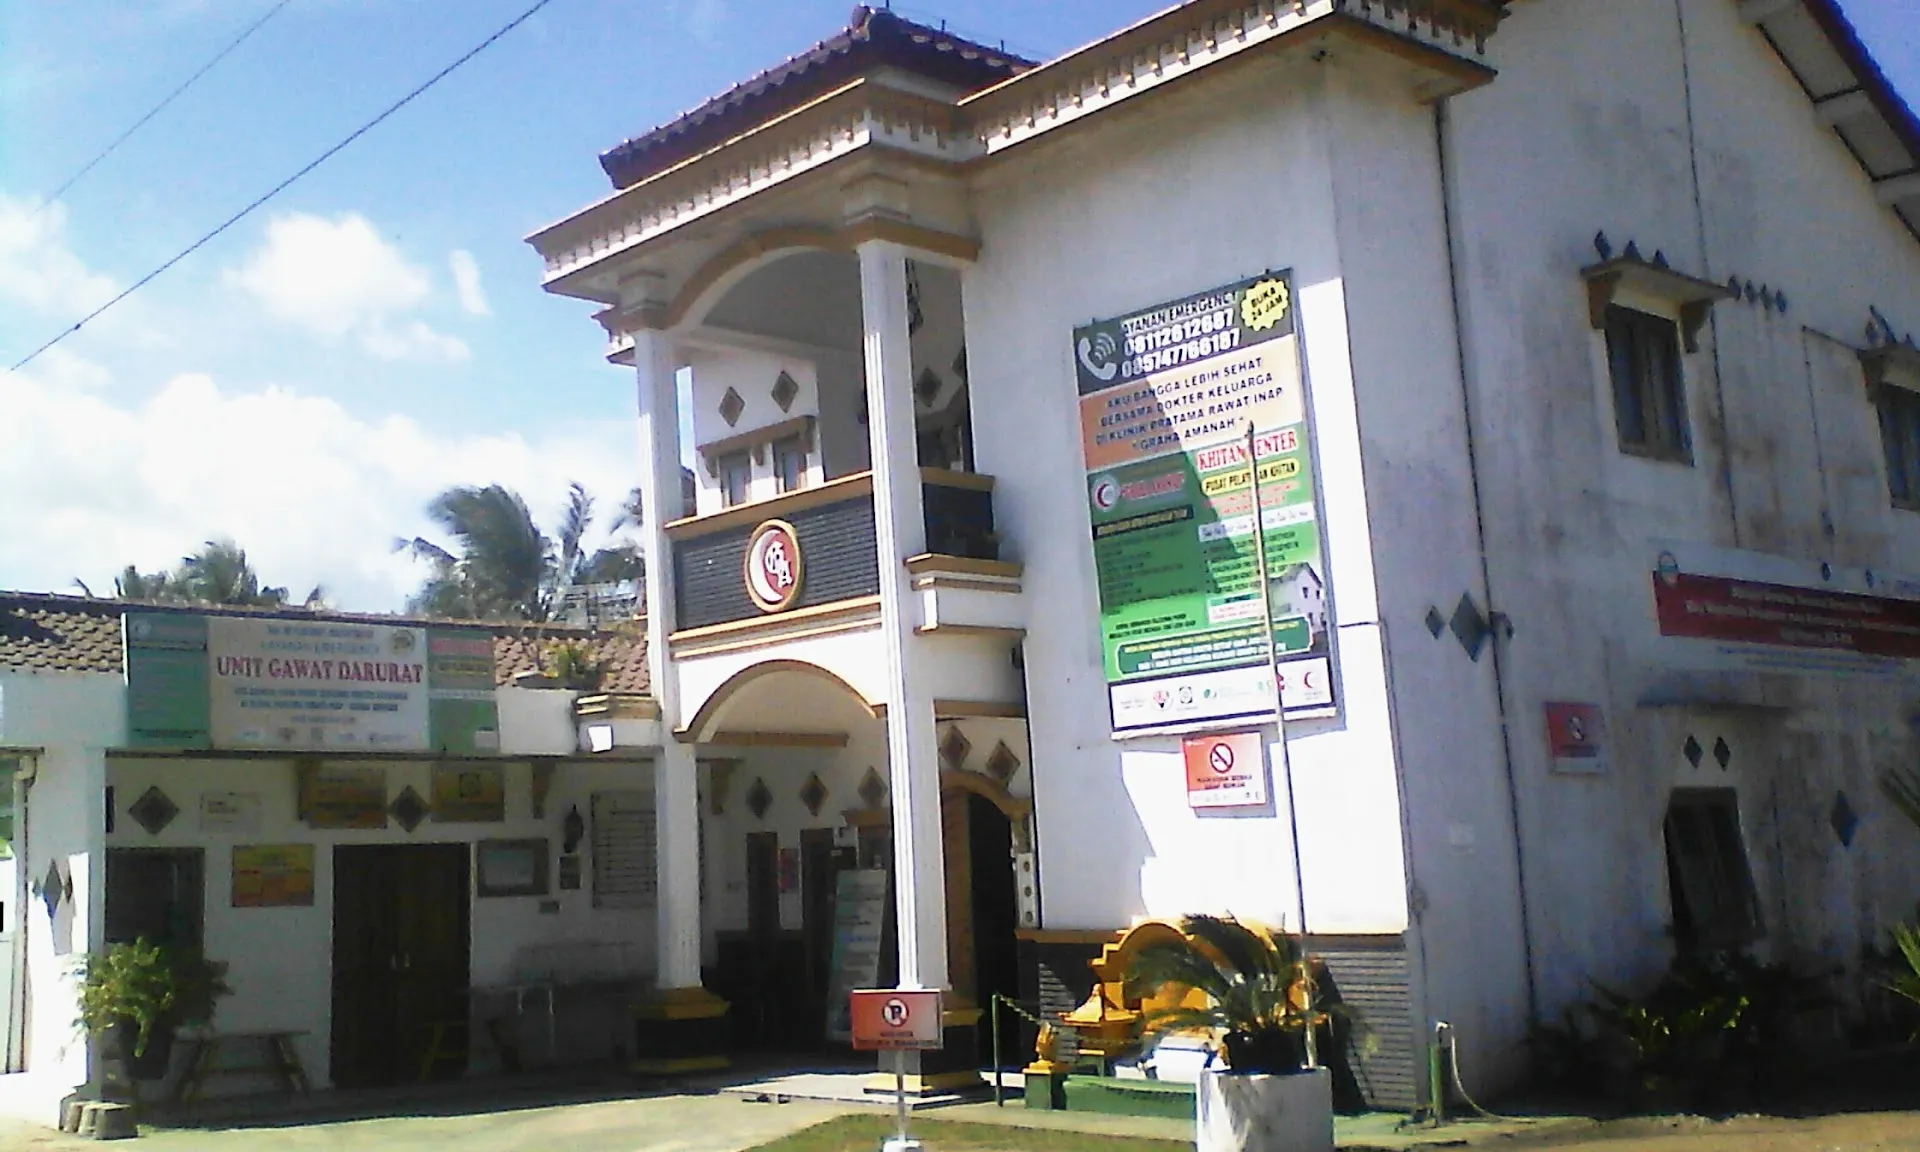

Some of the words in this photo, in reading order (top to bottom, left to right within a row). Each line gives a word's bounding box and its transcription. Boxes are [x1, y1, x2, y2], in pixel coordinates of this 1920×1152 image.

[1251, 287, 1276, 308] BUKA
[1266, 295, 1283, 313] JAM
[1133, 381, 1181, 403] BANGGA
[1185, 369, 1220, 389] LEBIH
[1224, 357, 1263, 377] SEHAT
[1100, 406, 1153, 427] BERSAMA
[1157, 393, 1205, 413] DOKTER
[1208, 372, 1273, 398] KELUARGA
[1110, 426, 1146, 441] KLINIK
[1150, 408, 1205, 431] PRATAMA
[1209, 395, 1250, 415] RAWAT
[1254, 386, 1283, 404] INAP
[1253, 431, 1297, 456] ENTER
[216, 656, 264, 678] UNIT
[268, 658, 333, 680] GAWAT
[338, 661, 424, 684] DARURAT
